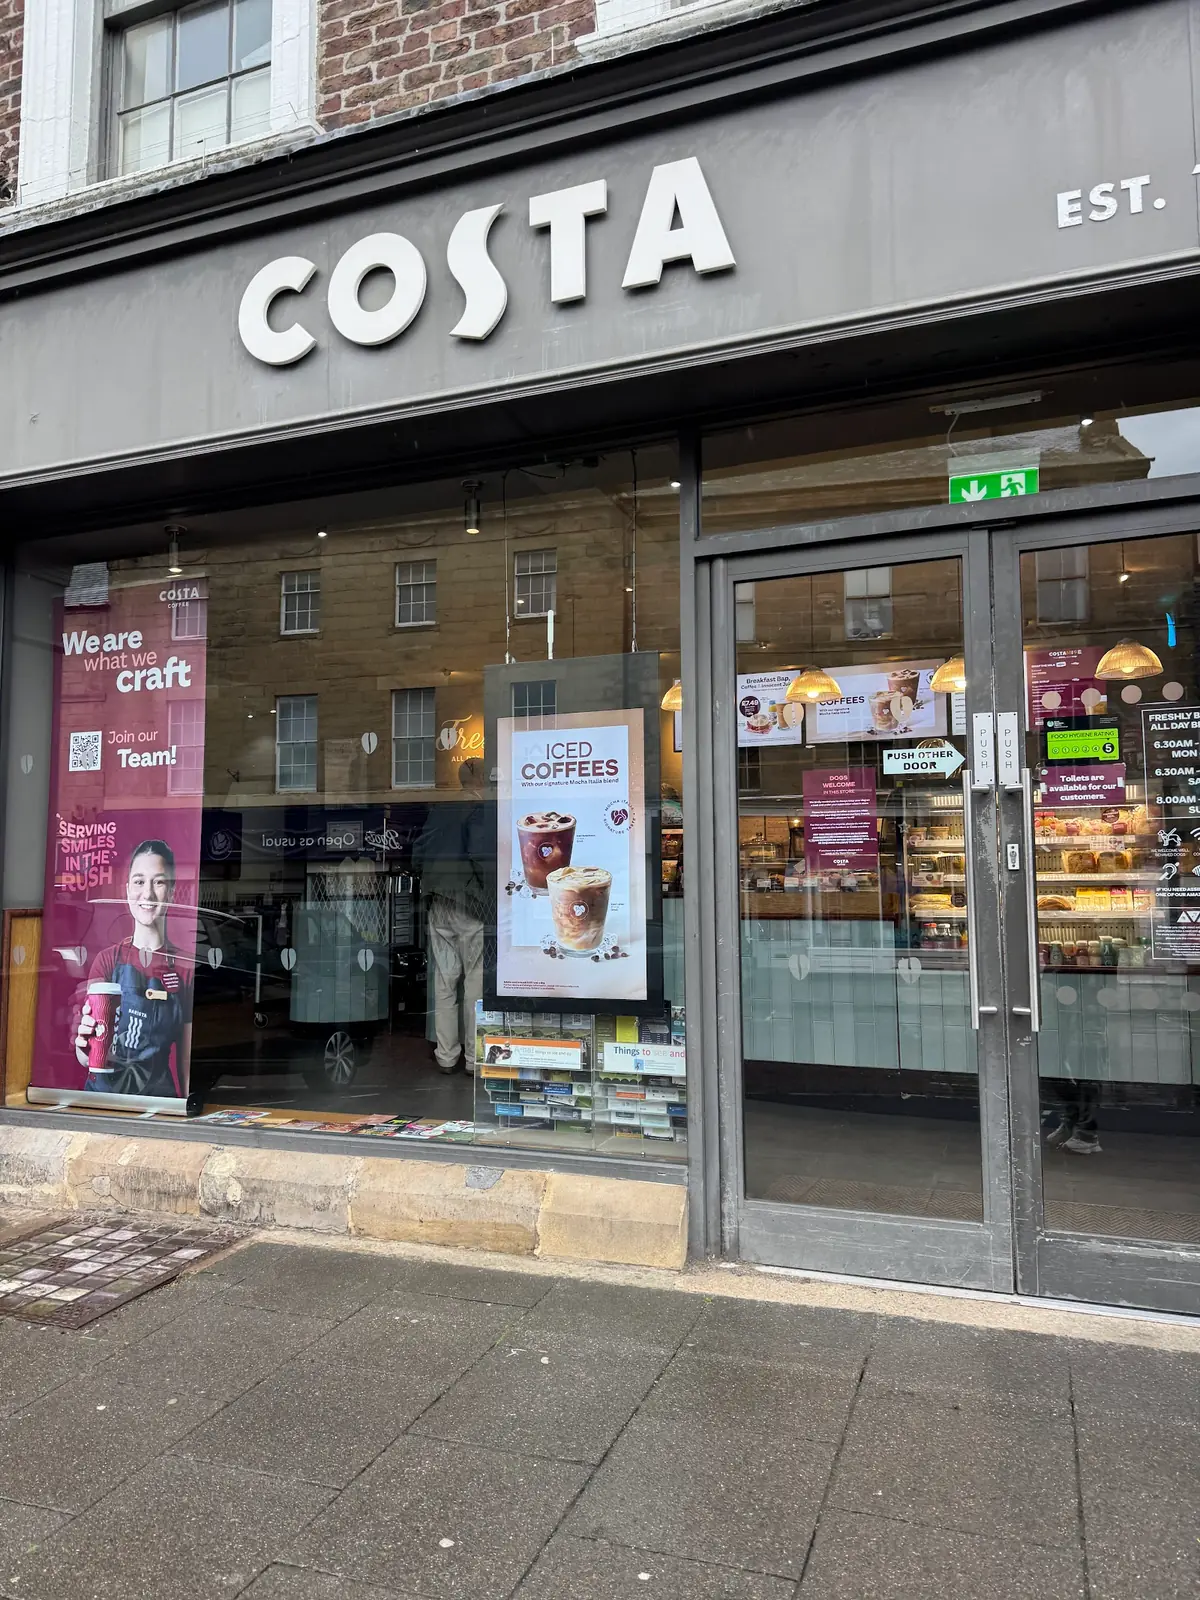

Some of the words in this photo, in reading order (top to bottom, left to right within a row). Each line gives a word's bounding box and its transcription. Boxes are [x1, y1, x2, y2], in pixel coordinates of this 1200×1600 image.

[1057, 174, 1166, 229] EST.
[237, 156, 737, 366] COSTA
[159, 586, 200, 602] COSTA
[62, 630, 100, 656] We
[102, 630, 143, 652] are
[84, 652, 128, 672] what
[132, 650, 158, 666] we
[116, 656, 192, 693] craft
[1149, 712, 1192, 722] FRESHLY
[108, 730, 135, 744] Join
[138, 730, 158, 742] our
[1153, 739, 1193, 749] 6.30AM
[117, 744, 177, 768] Team!
[546, 742, 593, 760] ICED
[918, 751, 953, 759] OTHER
[1105, 744, 1112, 752] 5
[1172, 750, 1197, 758] MON
[521, 759, 619, 780] COFFEES
[903, 762, 937, 770] DOOR
[1155, 767, 1194, 776] 6.30AM
[1156, 795, 1196, 804] 8.00AM
[59, 820, 117, 838] SERVING
[61, 835, 116, 854] SMILES
[65, 856, 80, 872] IN
[82, 850, 110, 868] THE
[61, 866, 113, 892] RUSH
[614, 1046, 640, 1056] Things
[670, 1050, 685, 1058] and
